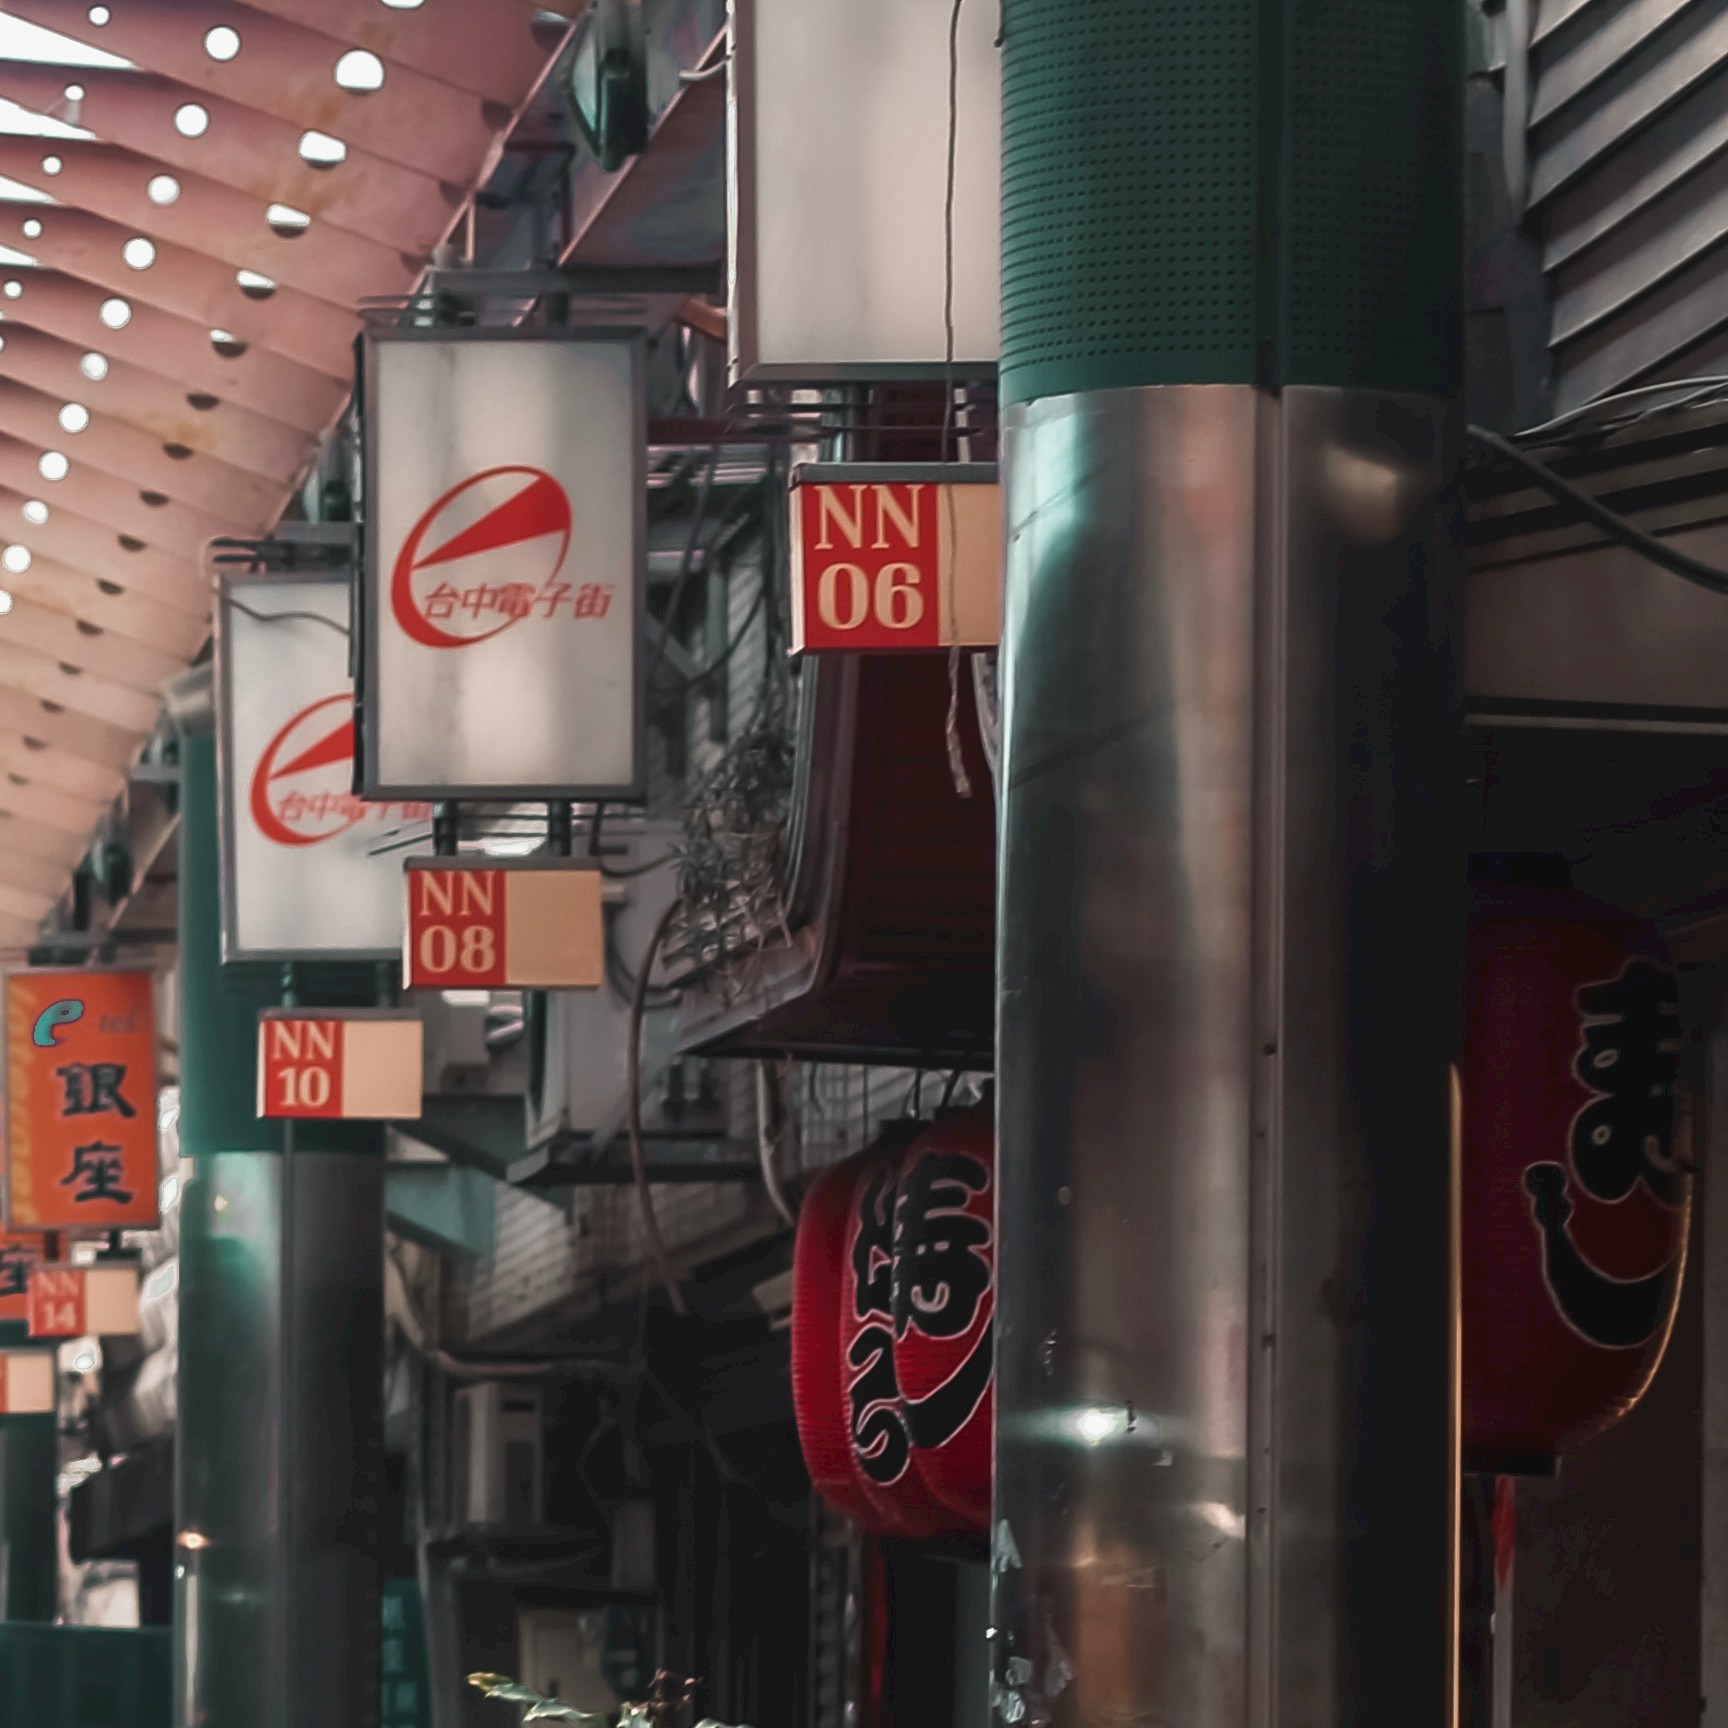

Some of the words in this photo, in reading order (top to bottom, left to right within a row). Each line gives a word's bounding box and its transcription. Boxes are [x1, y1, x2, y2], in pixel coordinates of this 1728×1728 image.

[815, 484, 926, 550] NN
[424, 581, 612, 622] 台中電子街
[817, 563, 924, 629] 06
[418, 870, 498, 917] NN
[419, 926, 496, 973] 08
[272, 1020, 336, 1061] NN
[276, 1067, 332, 1108] 10
[37, 1269, 81, 1297] NN
[44, 1302, 76, 1329] 14
